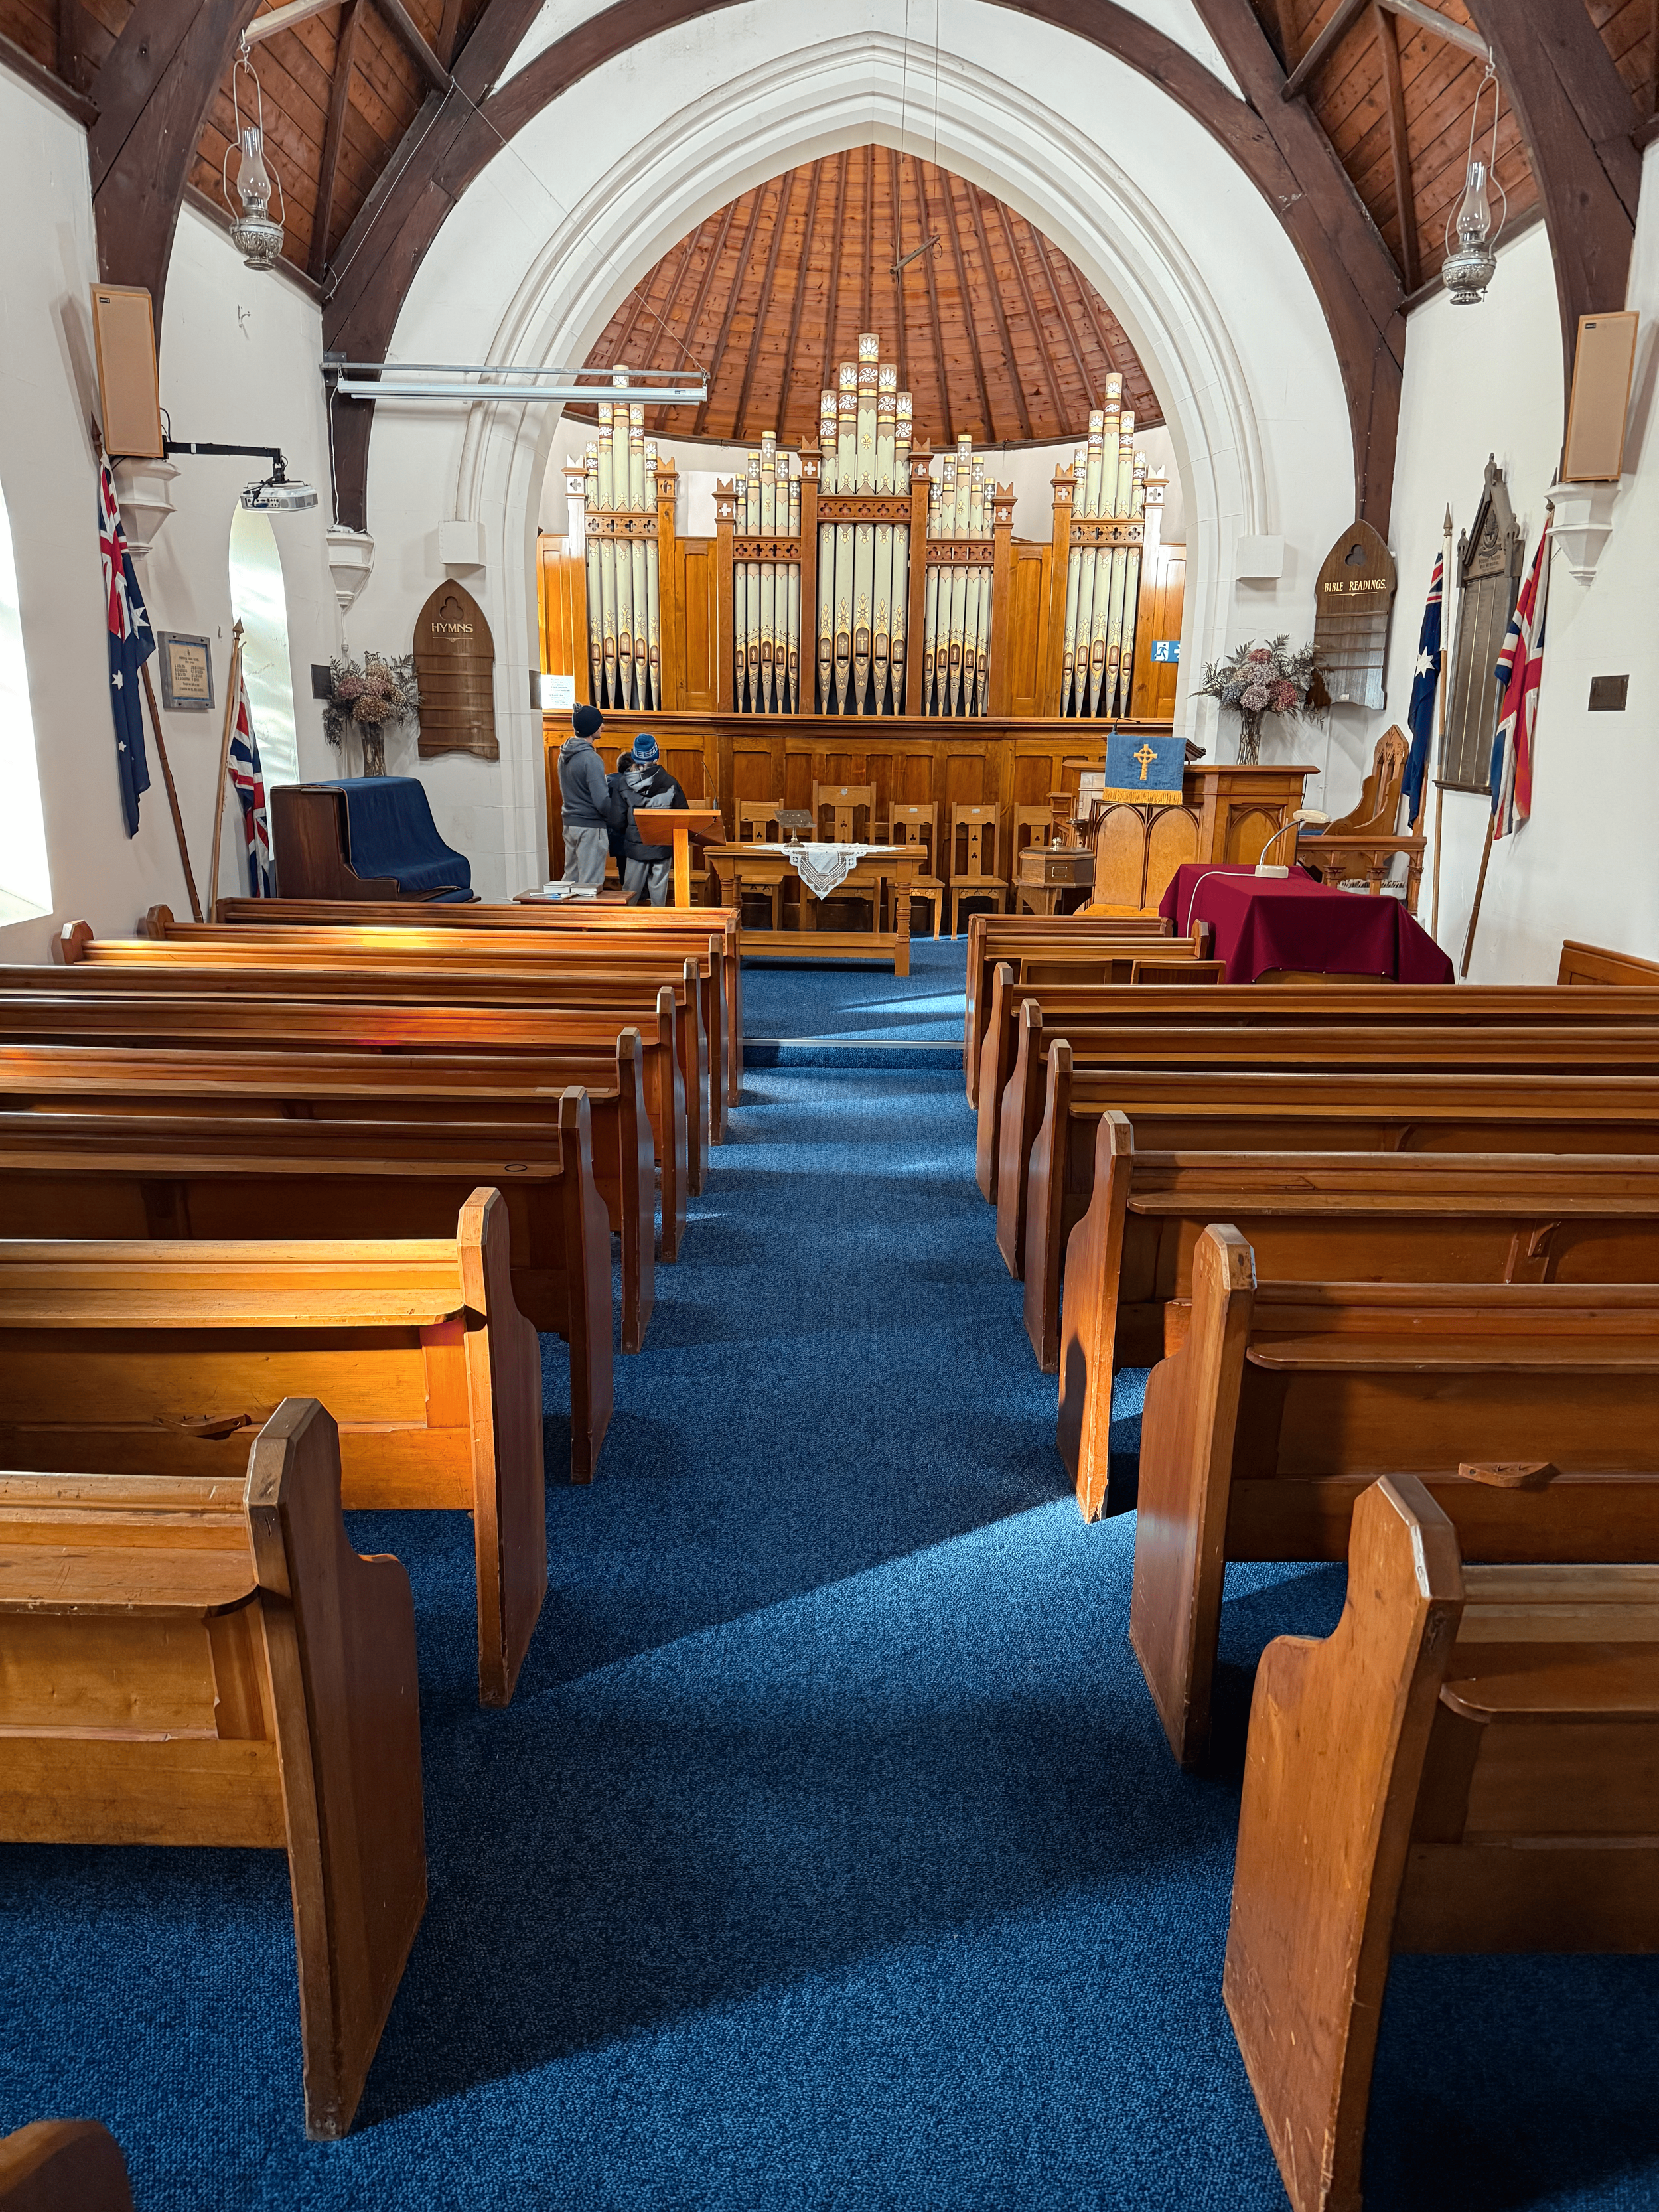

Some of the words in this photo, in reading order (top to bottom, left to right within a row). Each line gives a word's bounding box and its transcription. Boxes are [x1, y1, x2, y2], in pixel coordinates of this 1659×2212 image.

[1324, 581, 1344, 593] BIBLE
[1349, 579, 1386, 591] READINGS.
[431, 623, 474, 633] HYMNS
